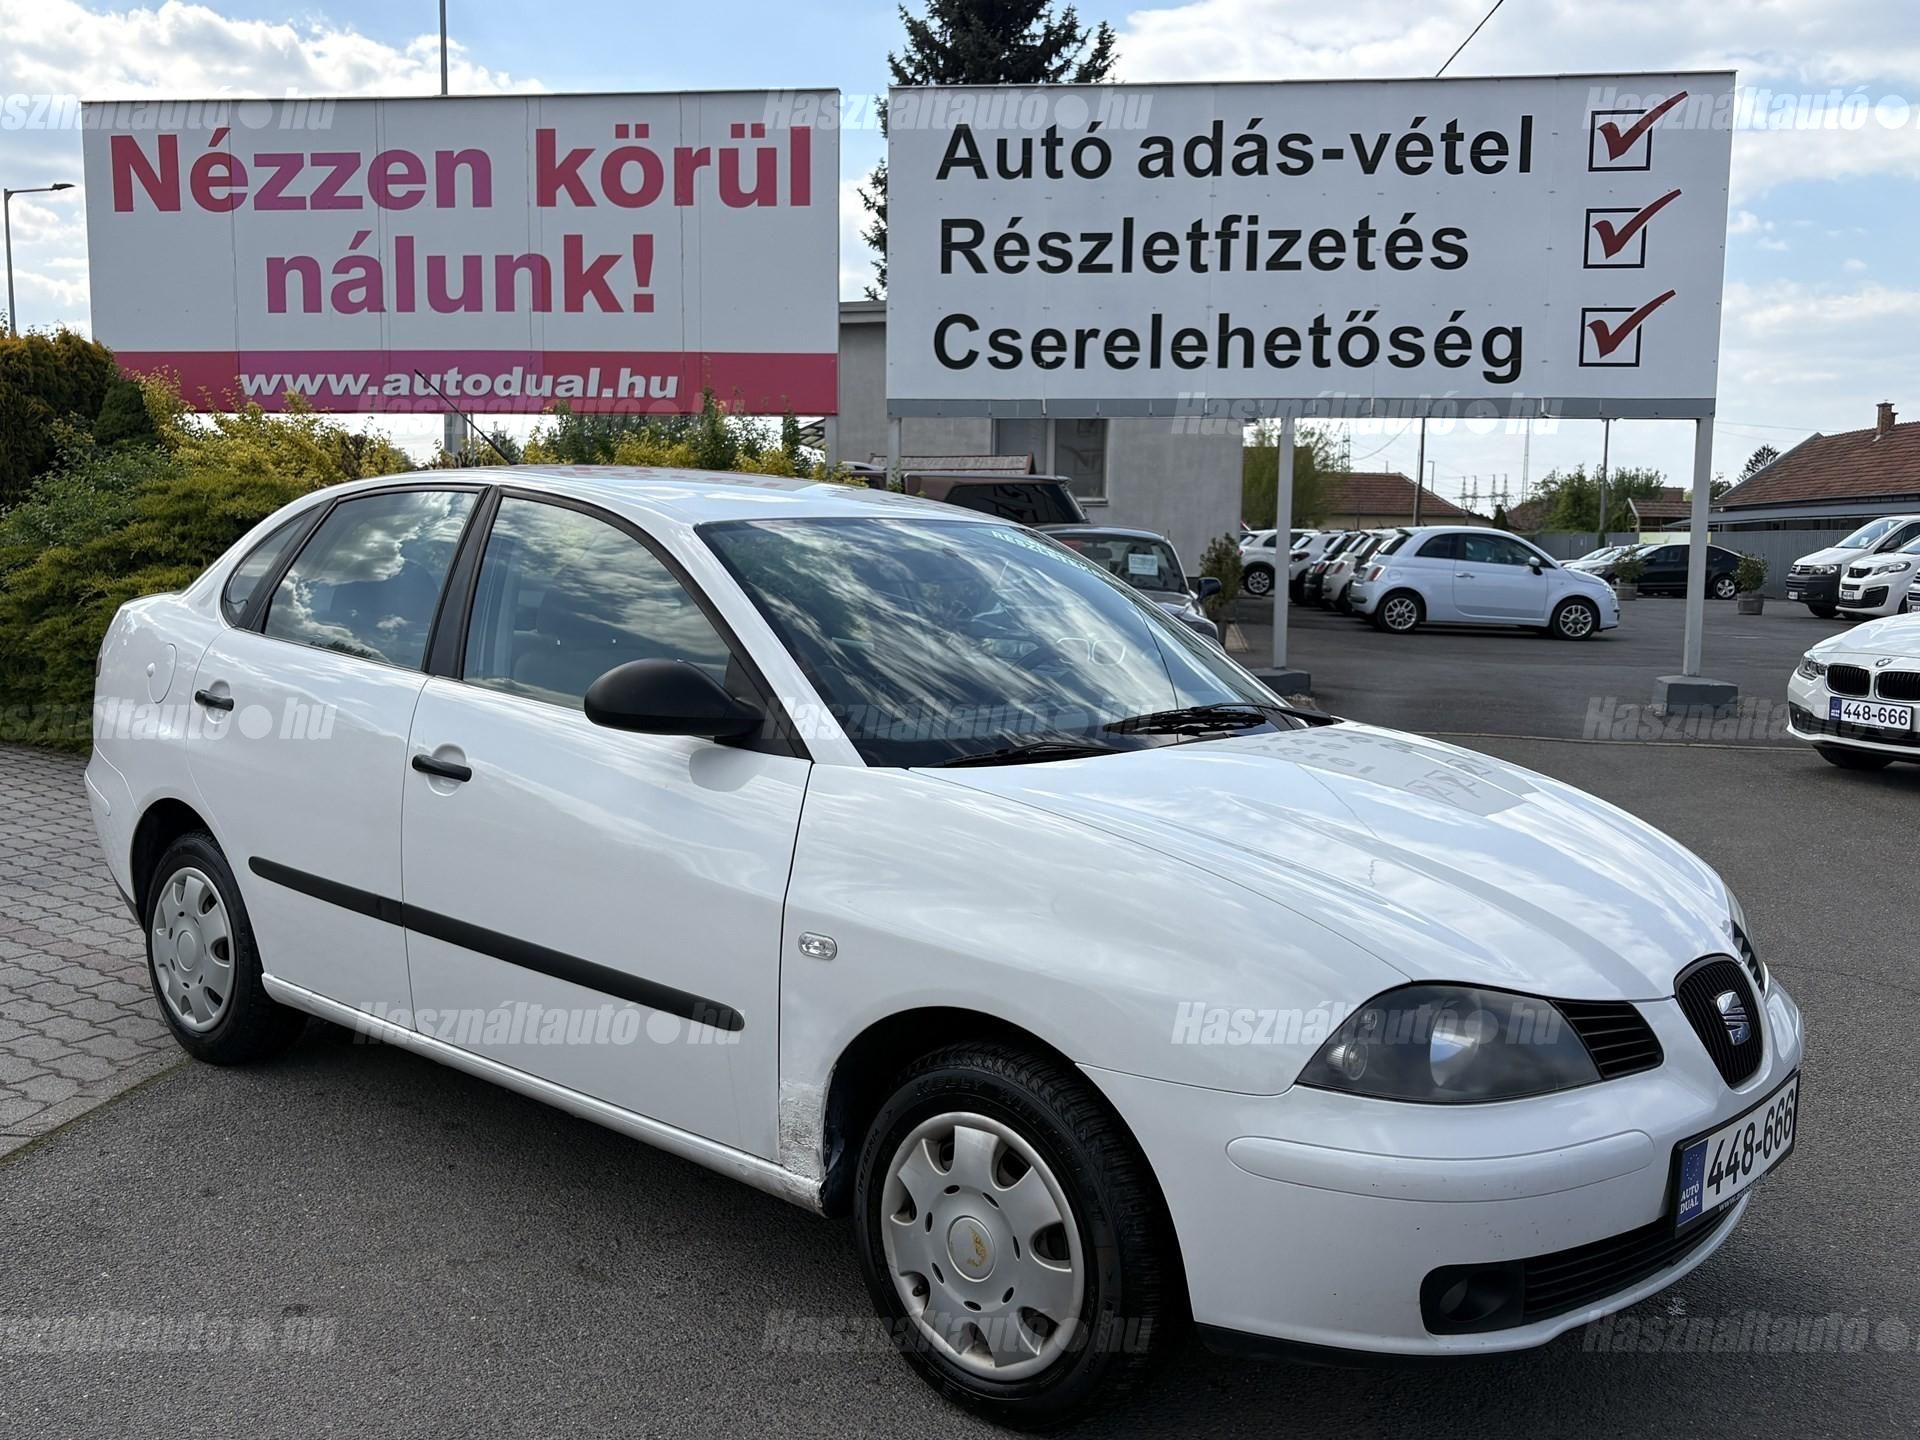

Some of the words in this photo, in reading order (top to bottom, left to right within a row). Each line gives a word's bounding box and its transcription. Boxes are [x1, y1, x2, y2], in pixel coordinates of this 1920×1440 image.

[111, 127, 493, 213] Nézzen
[536, 123, 812, 208] körül
[936, 120, 1113, 181] Autó
[1139, 115, 1533, 179] adás-vétel
[267, 230, 654, 315] nálunk!
[940, 212, 1469, 275] Részletfizetés
[934, 308, 1524, 384] Cserelehetőség
[240, 366, 679, 399] www.autodual.hu
[1843, 702, 1908, 726] 448-666
[1706, 1088, 1795, 1195] 448-666
[1680, 1195, 1699, 1215] DUAL
